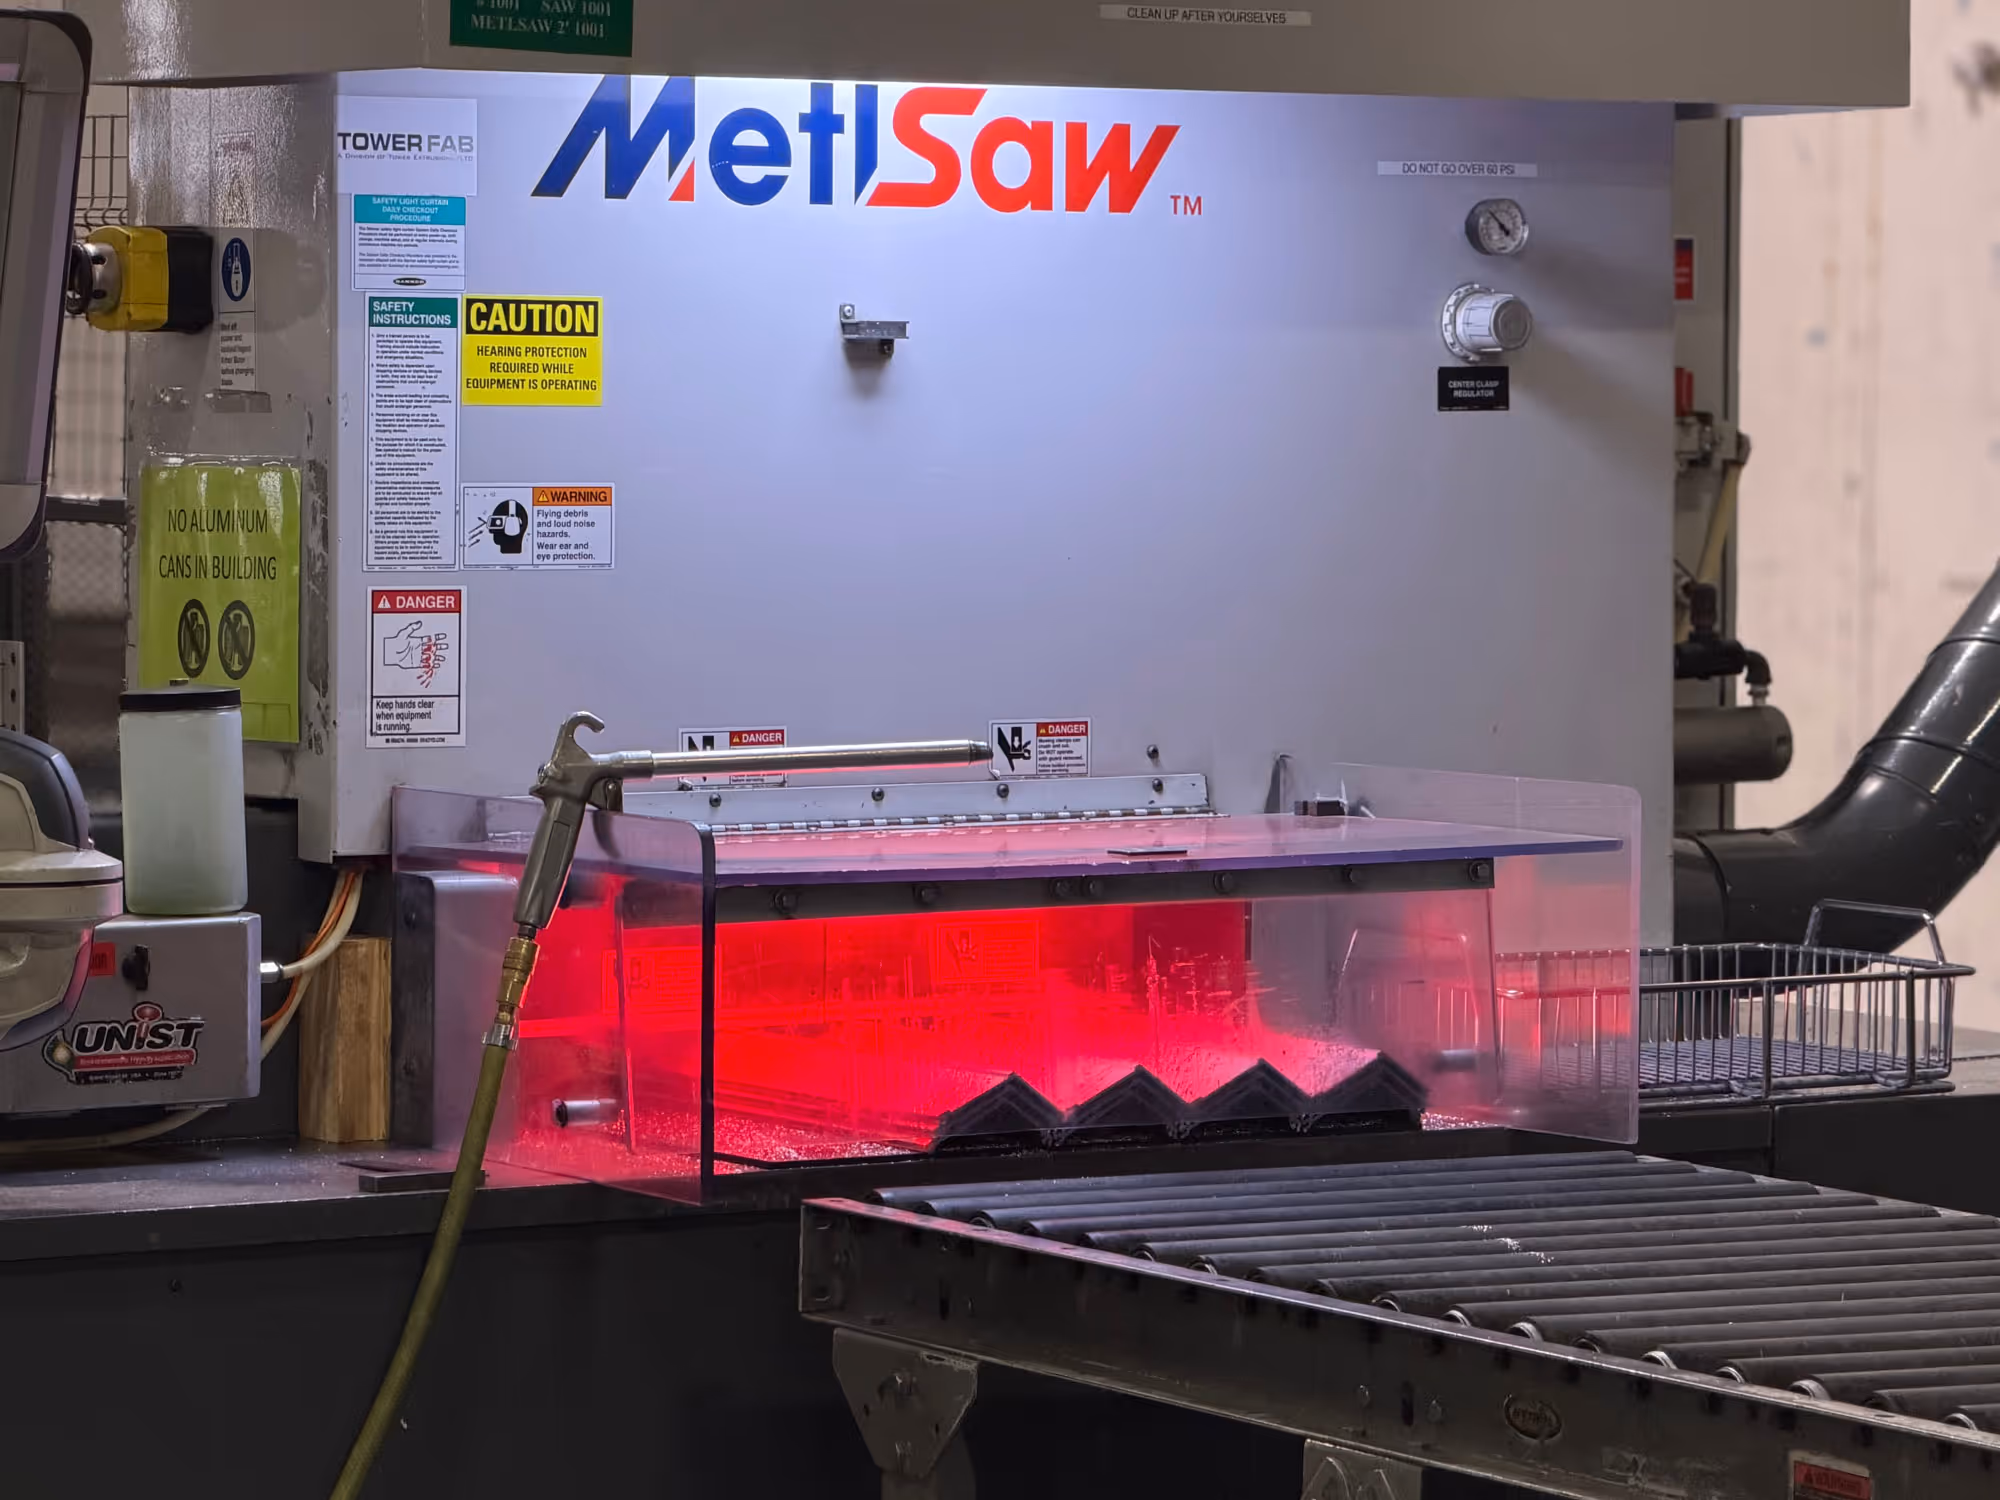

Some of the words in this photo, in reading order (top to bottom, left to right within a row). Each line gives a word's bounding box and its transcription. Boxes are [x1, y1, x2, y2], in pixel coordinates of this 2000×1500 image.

[541, 0, 577, 14] SAW
[581, 1, 611, 17] 1001
[1127, 7, 1161, 20] CLEAN
[1164, 9, 1179, 21] UP
[1181, 10, 1215, 22] AFTER
[1218, 11, 1286, 24] YOURSELVES
[471, 14, 553, 33] METLSAW
[575, 22, 605, 38] 1001
[337, 132, 423, 152] TOWER
[427, 134, 474, 153] FAB
[530, 74, 1181, 214] MetlSaw
[1170, 195, 1202, 215] TM
[1402, 163, 1417, 174] DO
[1419, 163, 1439, 174] NOT
[1441, 164, 1456, 174] GO
[1458, 164, 1485, 175] OVER
[1486, 164, 1498, 175] 60
[1500, 164, 1515, 175] PSI
[372, 196, 397, 205] SAFETY
[399, 197, 418, 205] LIGHT
[420, 198, 449, 206] CURTAIN
[402, 206, 438, 214] CHECKOUT
[390, 214, 432, 222] PROCEDURE
[373, 301, 415, 312] SAFETY
[373, 313, 452, 325] INSTRUCTIONS
[470, 302, 595, 333] CAUTION
[477, 345, 522, 357] HEARING
[525, 346, 587, 358] PROTECTION
[490, 362, 539, 374] REQUIRED
[542, 363, 574, 374] WHILE
[466, 378, 526, 390] EQUIPMENT
[528, 378, 538, 390] IS
[541, 379, 597, 391] OPERATING
[1448, 380, 1475, 389] CENTER
[1453, 389, 1494, 398] REGULATOR
[551, 491, 607, 503] WARNING
[536, 509, 562, 519] Flying
[563, 509, 589, 518] debris
[168, 509, 187, 532] NO
[190, 509, 268, 533] ALUMINUM
[536, 520, 552, 528] and
[554, 520, 572, 528] loud
[573, 520, 596, 528] noise
[536, 530, 571, 538] hazards.
[536, 542, 557, 550] Wear
[573, 542, 589, 550] and
[536, 552, 551, 561] eye
[552, 552, 596, 561] protection.
[159, 554, 192, 579] CANS
[195, 555, 208, 579] IN
[212, 556, 277, 581] BUILDING
[396, 595, 455, 609] DANGER
[375, 700, 394, 710] Keep
[395, 699, 417, 709] hands
[417, 699, 435, 709] clear
[375, 711, 394, 720] when
[396, 710, 432, 722] equipment
[375, 722, 382, 731] is
[383, 722, 412, 733] running.
[1048, 724, 1086, 734] DANGER
[742, 732, 783, 743] DANGER
